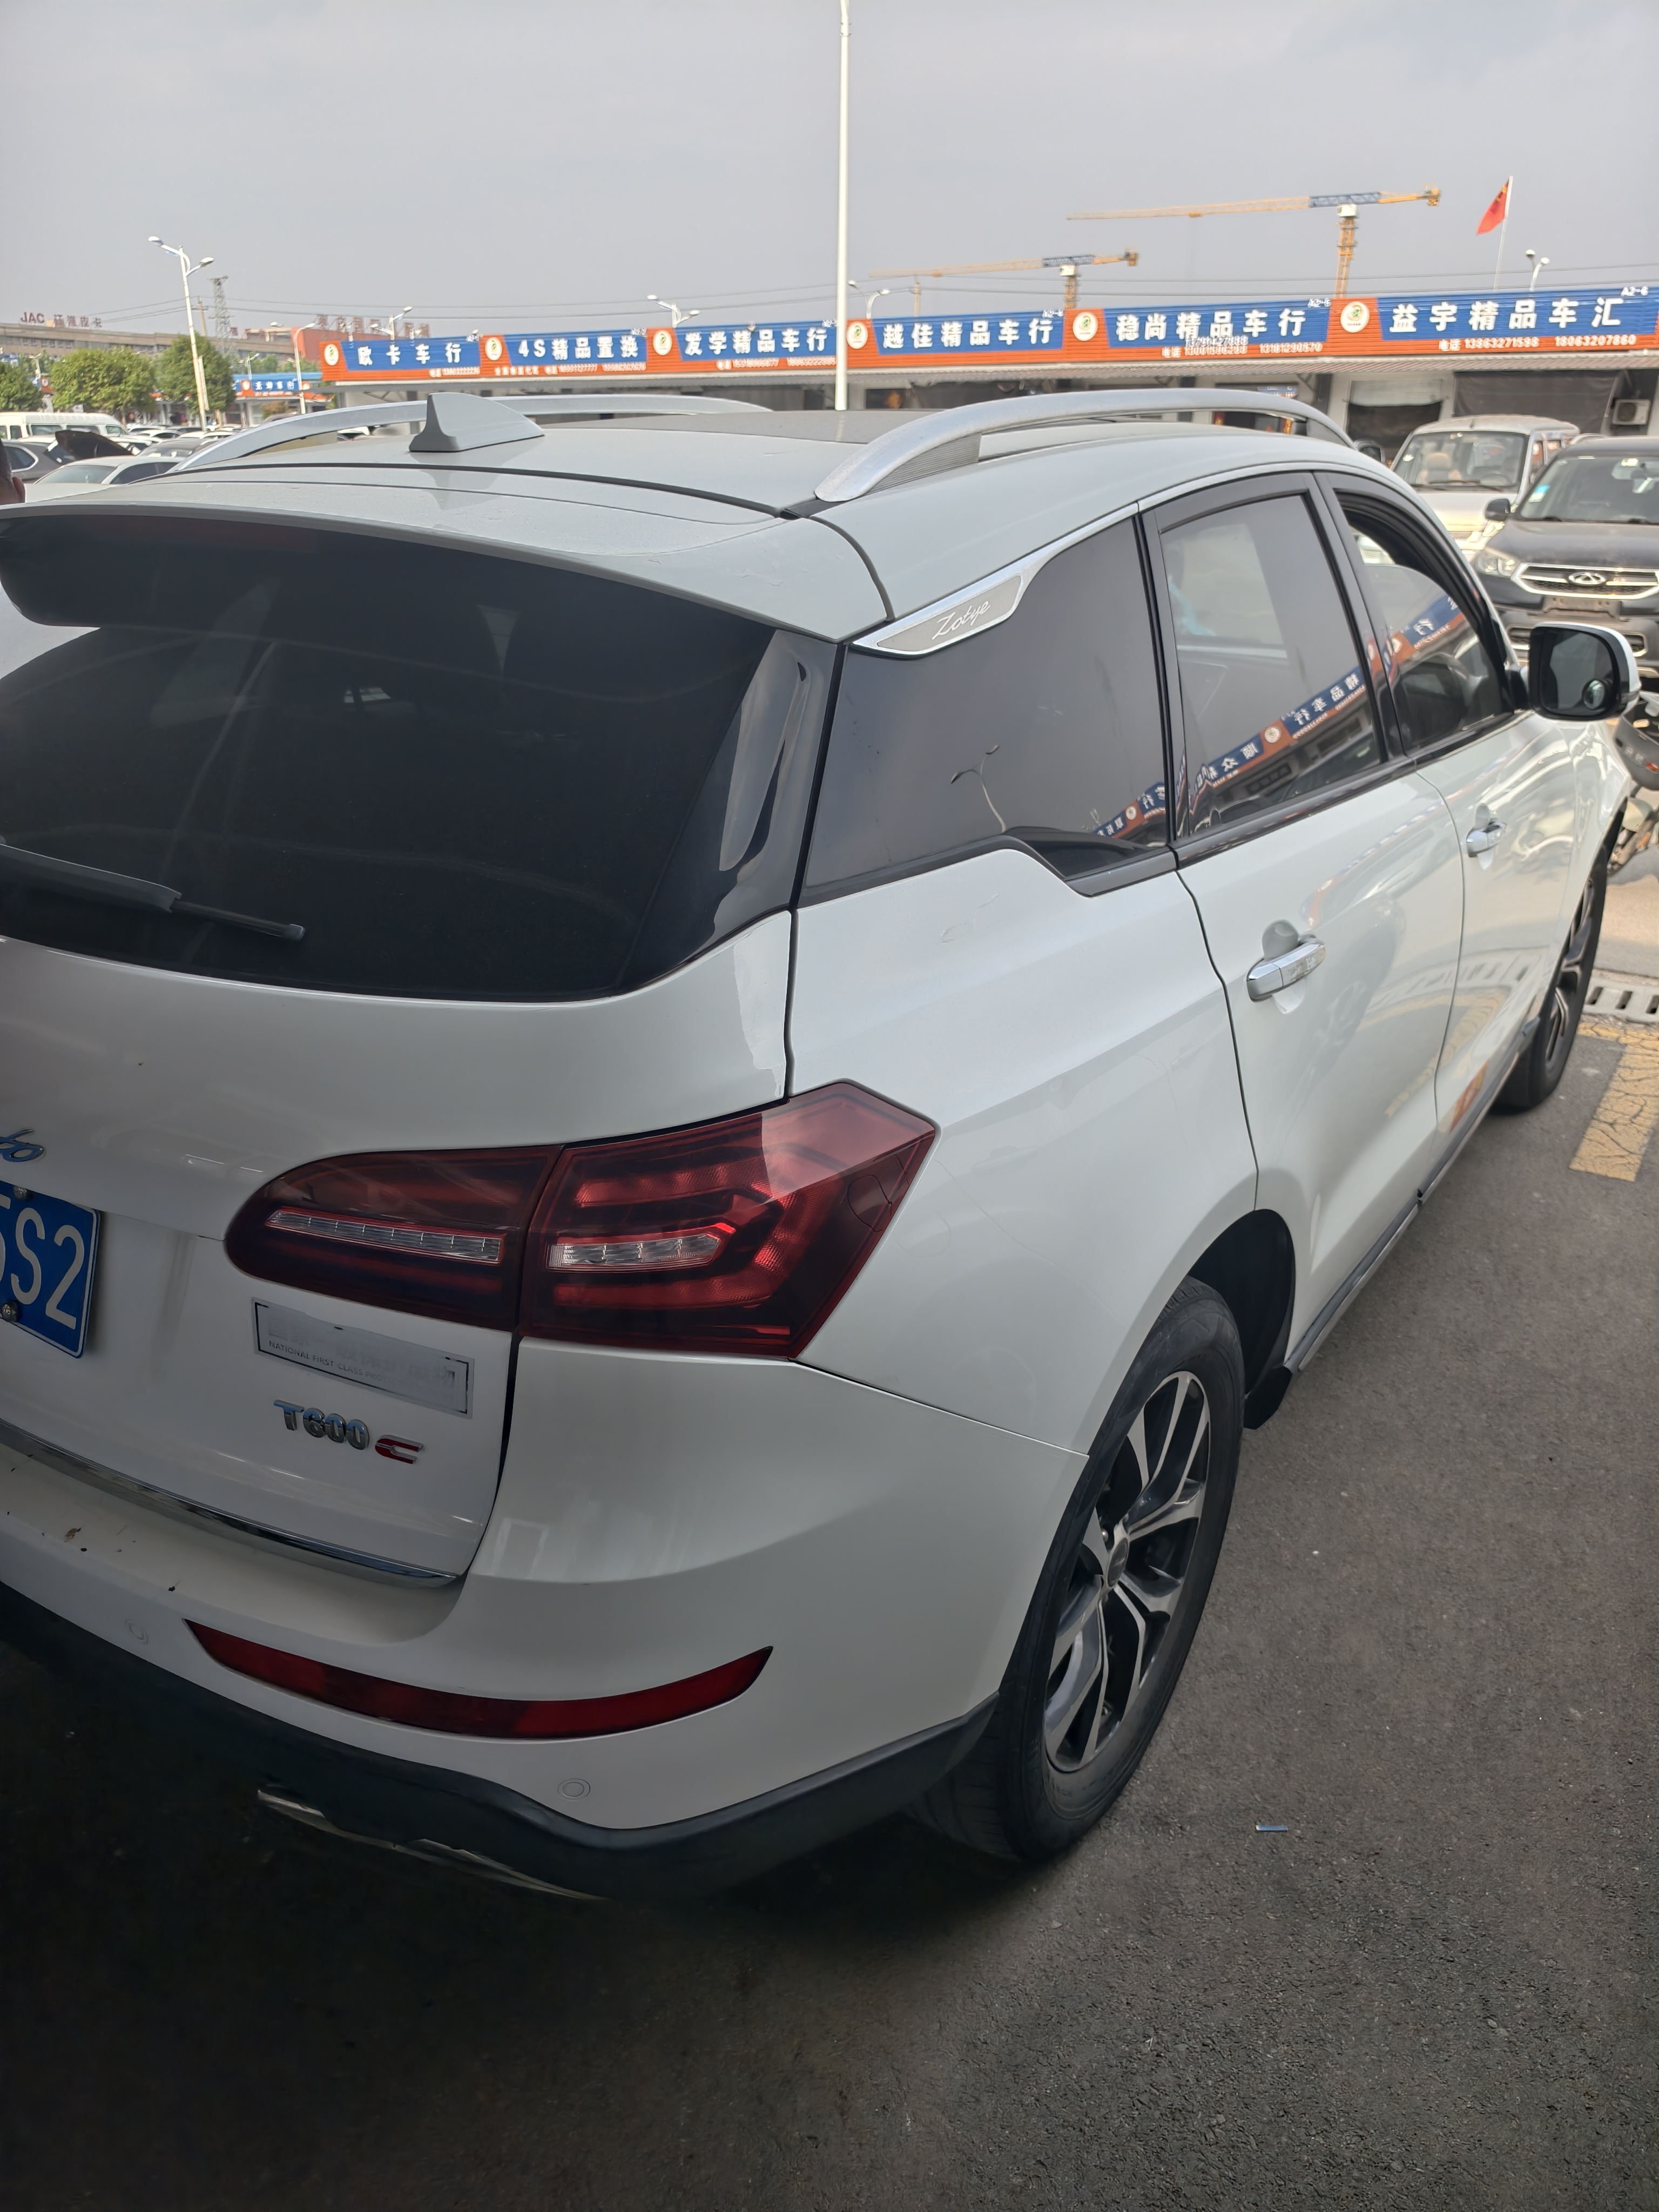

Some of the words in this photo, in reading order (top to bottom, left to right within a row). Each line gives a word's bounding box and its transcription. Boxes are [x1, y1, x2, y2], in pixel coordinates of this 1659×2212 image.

[21, 312, 45, 324] JAC
[1116, 308, 1306, 341] 稳尚精品车行
[1390, 297, 1624, 333] 益宇精品车汇
[685, 327, 827, 356] 发学精品车行
[882, 318, 1053, 349] 越佳精品车行
[358, 342, 461, 366] 欧卡车行
[932, 601, 990, 639] Zotye
[0, 1193, 85, 1330] S2
[269, 1340, 309, 1359] NATIONAL
[273, 1399, 370, 1451] T600
